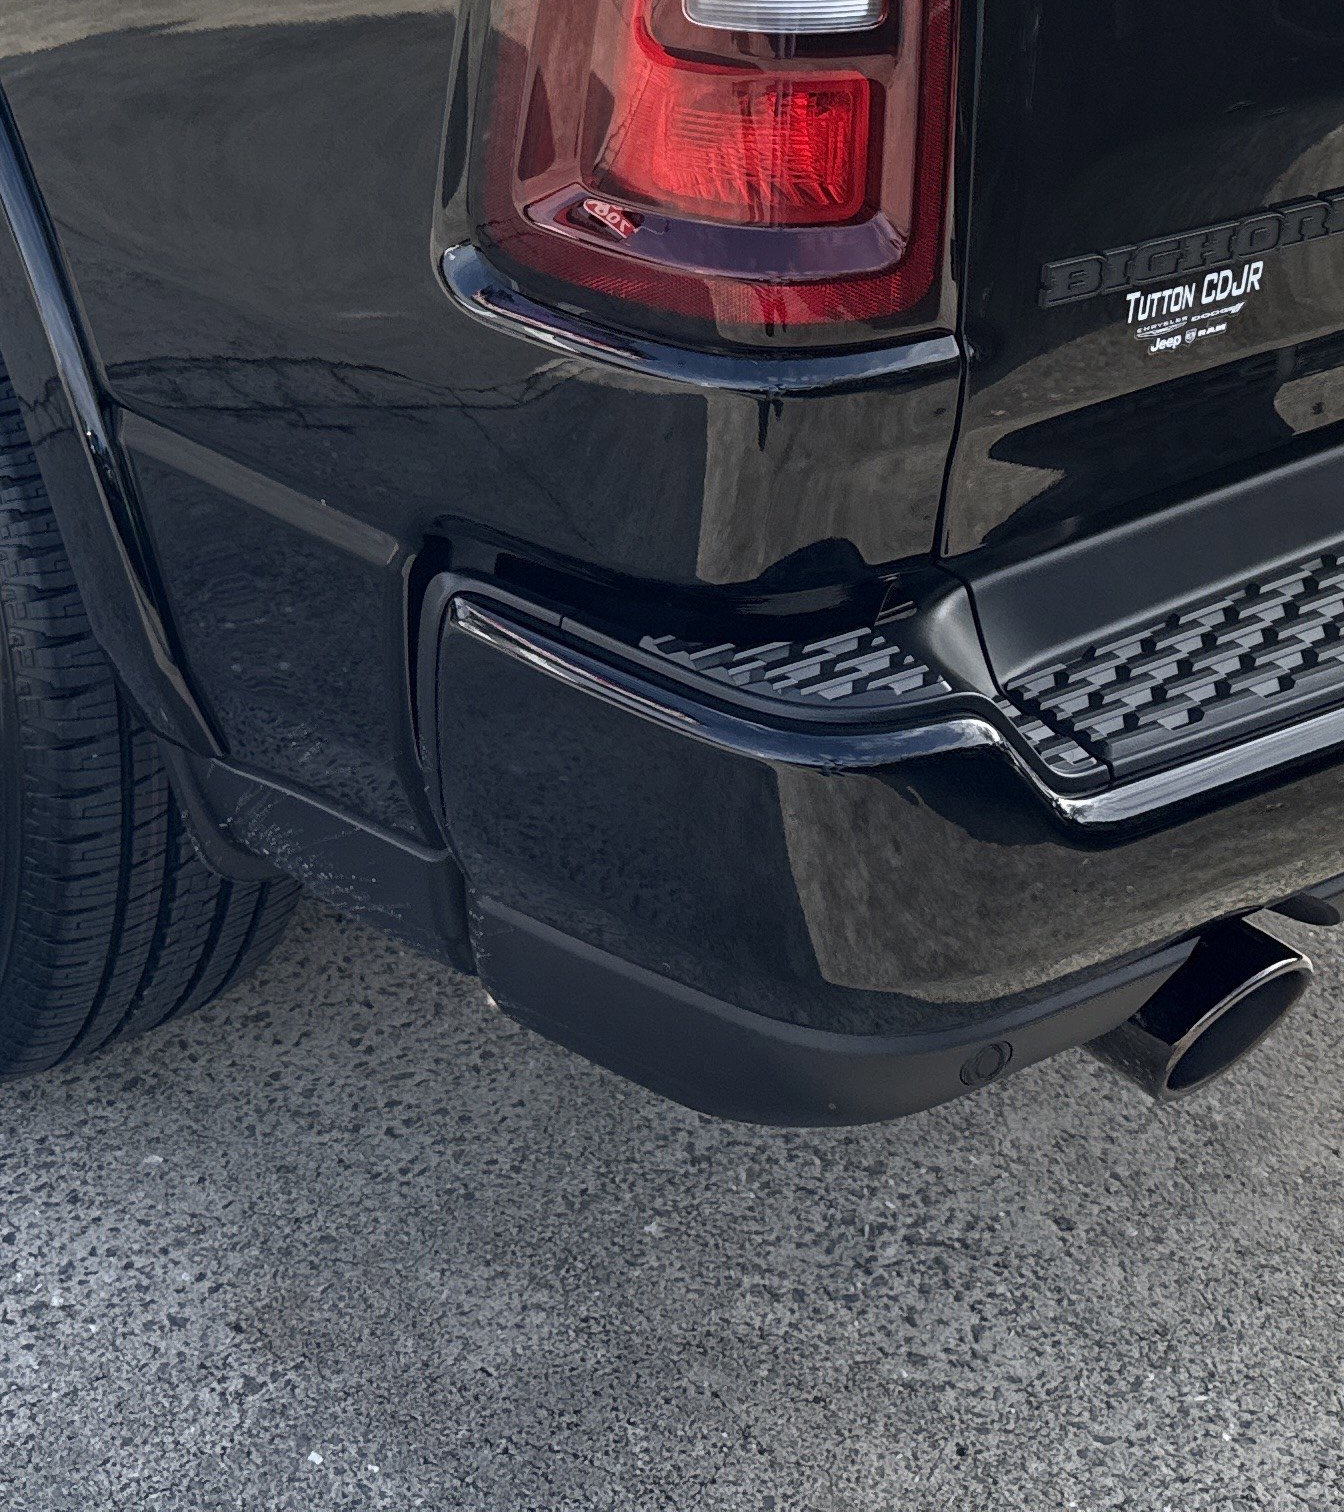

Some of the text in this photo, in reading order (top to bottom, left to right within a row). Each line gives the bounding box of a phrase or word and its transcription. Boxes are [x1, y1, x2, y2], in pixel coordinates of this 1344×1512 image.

[1126, 261, 1263, 324] TUTTON CDJR
[1150, 323, 1227, 352] Jeep RAM
